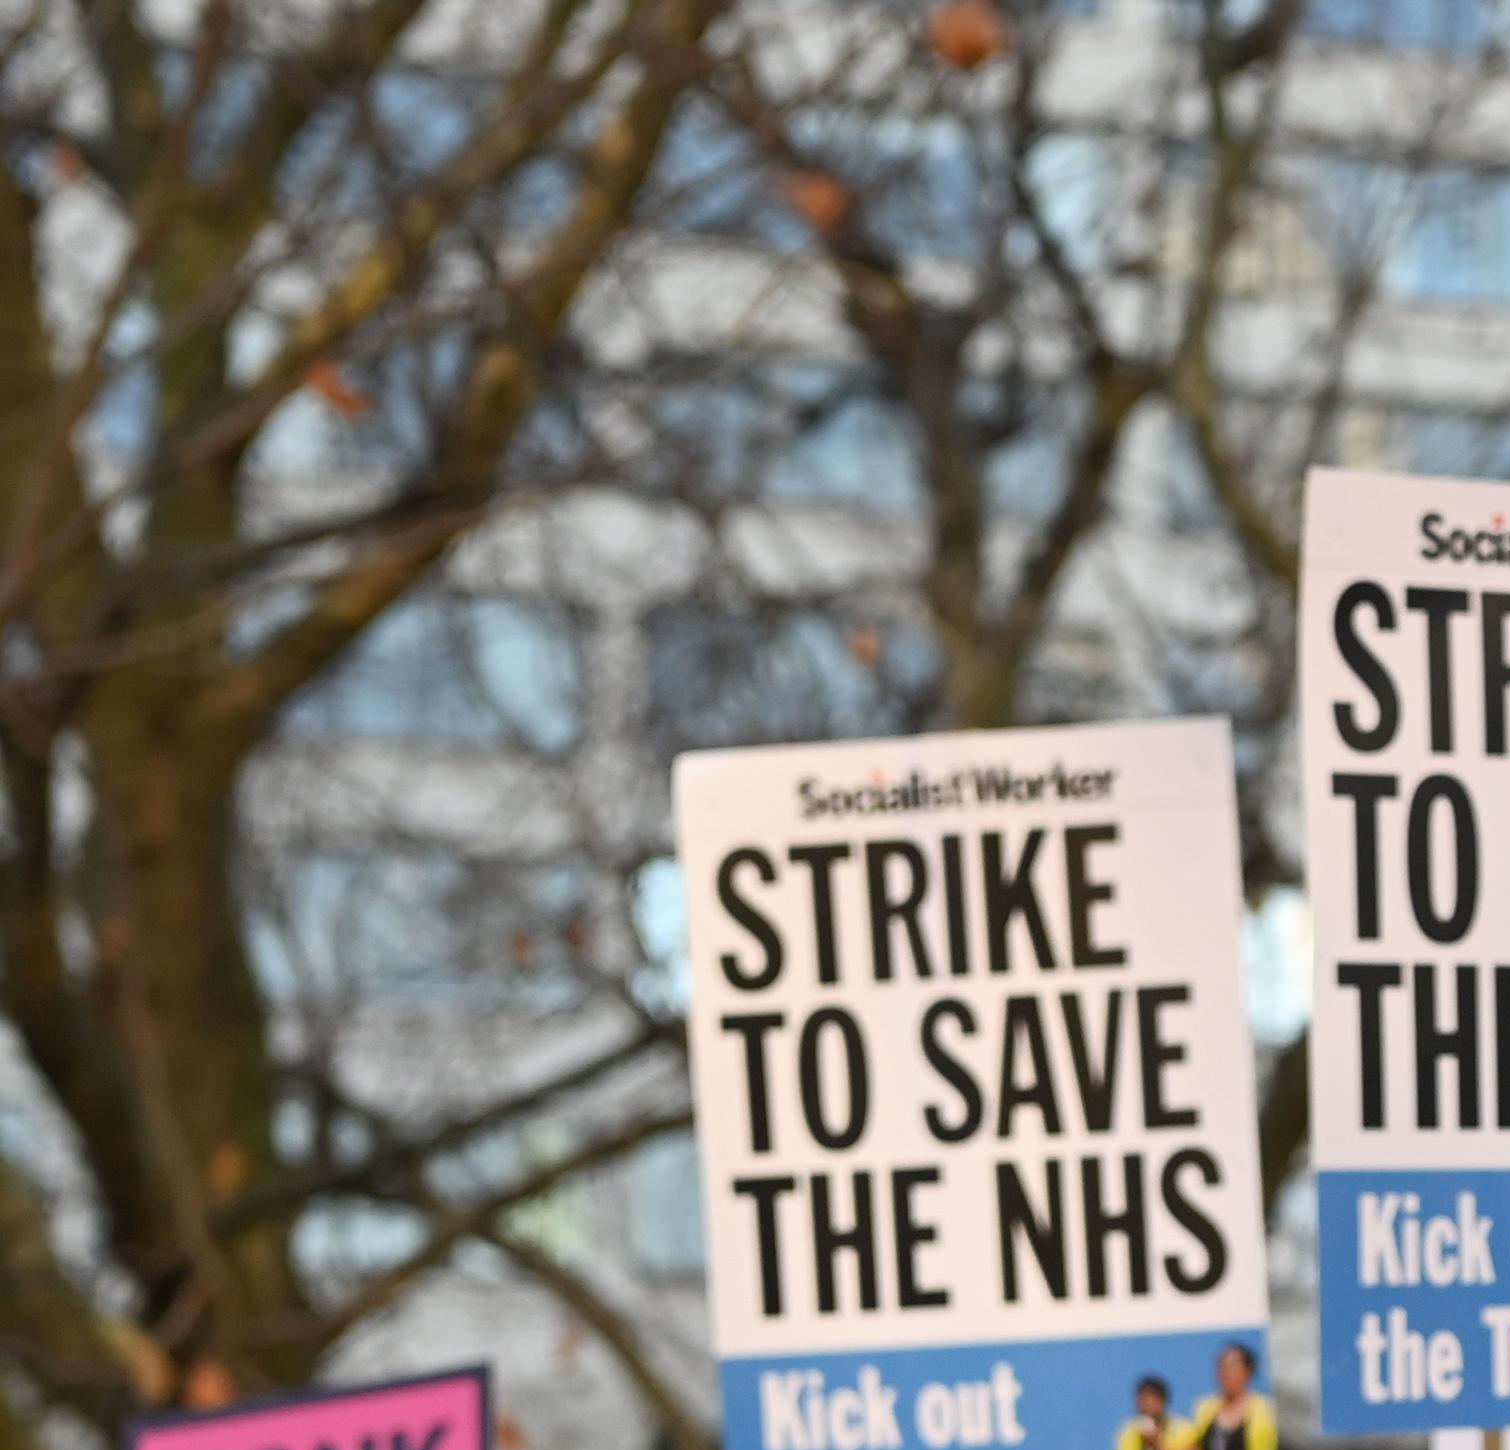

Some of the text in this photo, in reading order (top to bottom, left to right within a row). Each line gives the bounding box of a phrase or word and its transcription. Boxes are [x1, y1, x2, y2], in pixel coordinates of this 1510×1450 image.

[716, 824, 1126, 991] STRIKE
[1332, 774, 1480, 944] TO
[721, 984, 1199, 1154] TO SAVE
[734, 1148, 1227, 1317] THE NHS
[1357, 1190, 1495, 1288] Kick
[918, 1364, 1025, 1448] out
[1357, 1309, 1466, 1402] the
